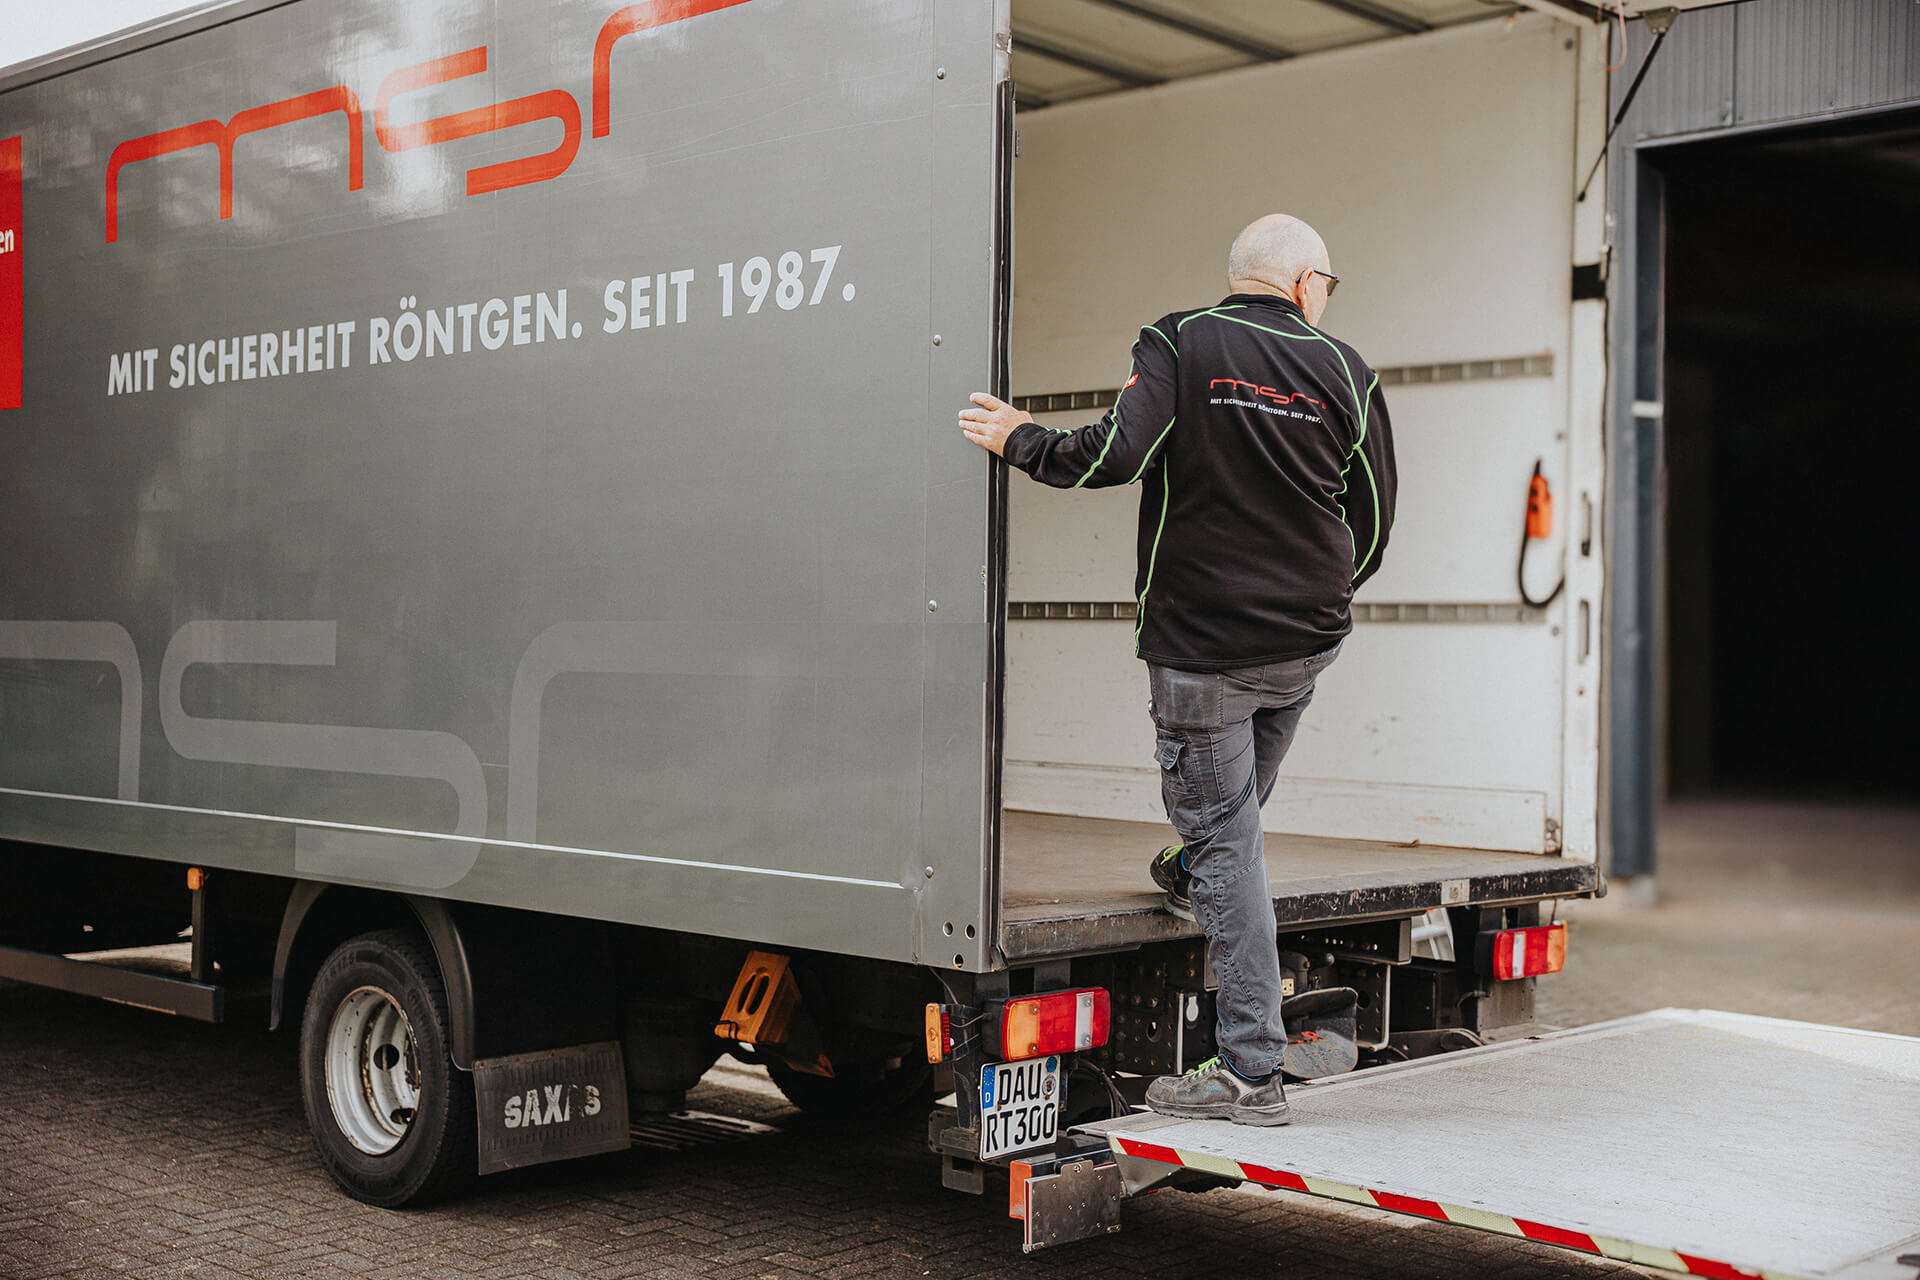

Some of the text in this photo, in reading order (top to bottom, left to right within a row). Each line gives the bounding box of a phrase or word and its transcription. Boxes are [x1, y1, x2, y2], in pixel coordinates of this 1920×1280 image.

[107, 245, 856, 395] MIT SICHERHEIT RÖNTGEN. SEIT 1987.
[1290, 411, 1304, 419] SEIT
[1305, 414, 1321, 424] 1987.
[985, 1092, 991, 1103] D
[998, 1063, 1042, 1105] DAU
